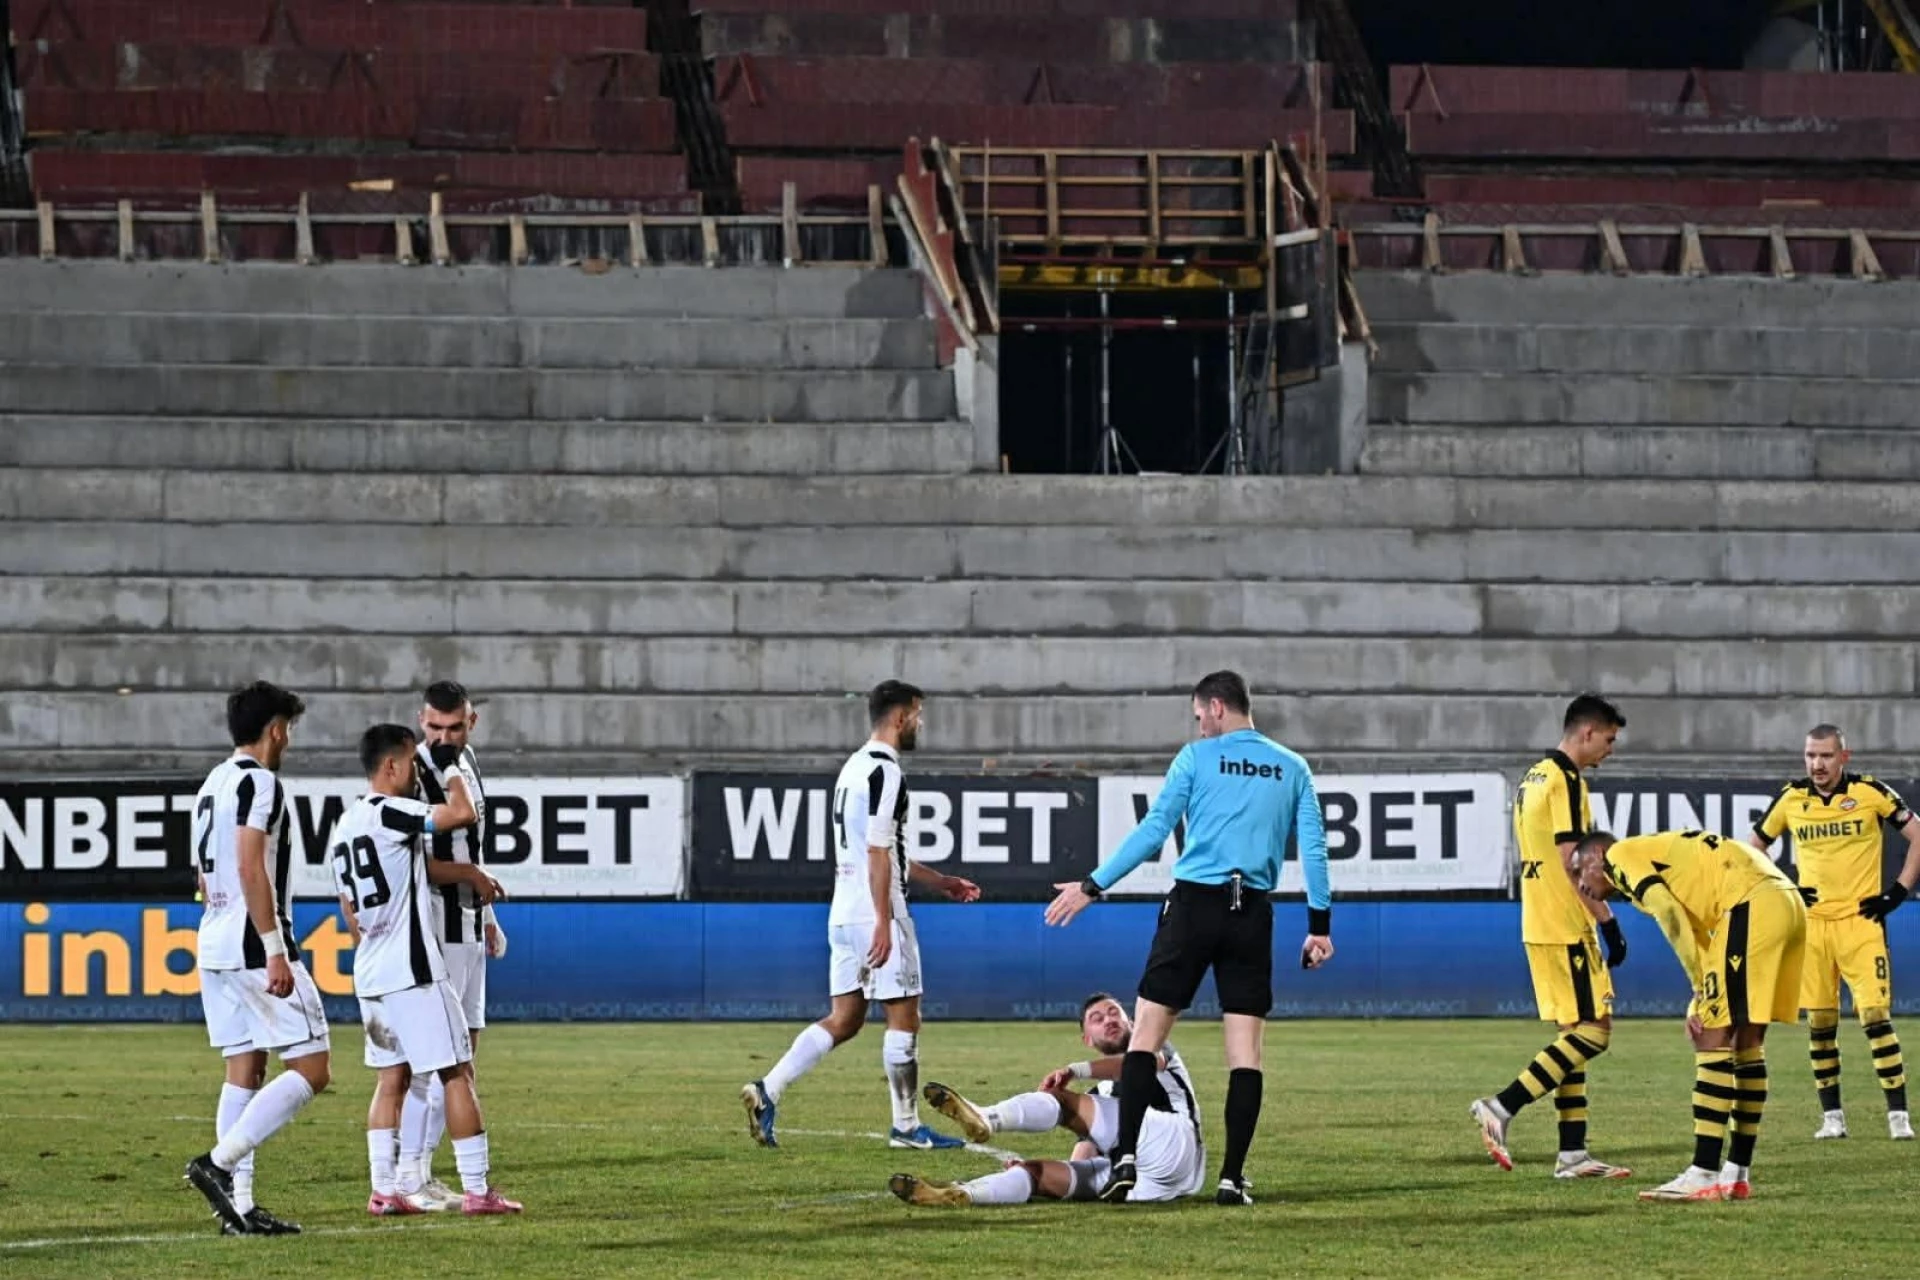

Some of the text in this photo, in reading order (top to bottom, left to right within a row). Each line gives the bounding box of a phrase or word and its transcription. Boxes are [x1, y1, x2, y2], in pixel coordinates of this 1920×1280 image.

[1220, 754, 1283, 781] inbet
[724, 786, 1069, 863] WIBET
[1796, 819, 1863, 840] WINBET
[333, 834, 391, 913] 39
[23, 903, 358, 996] inbt
[1874, 955, 1887, 980] 8
